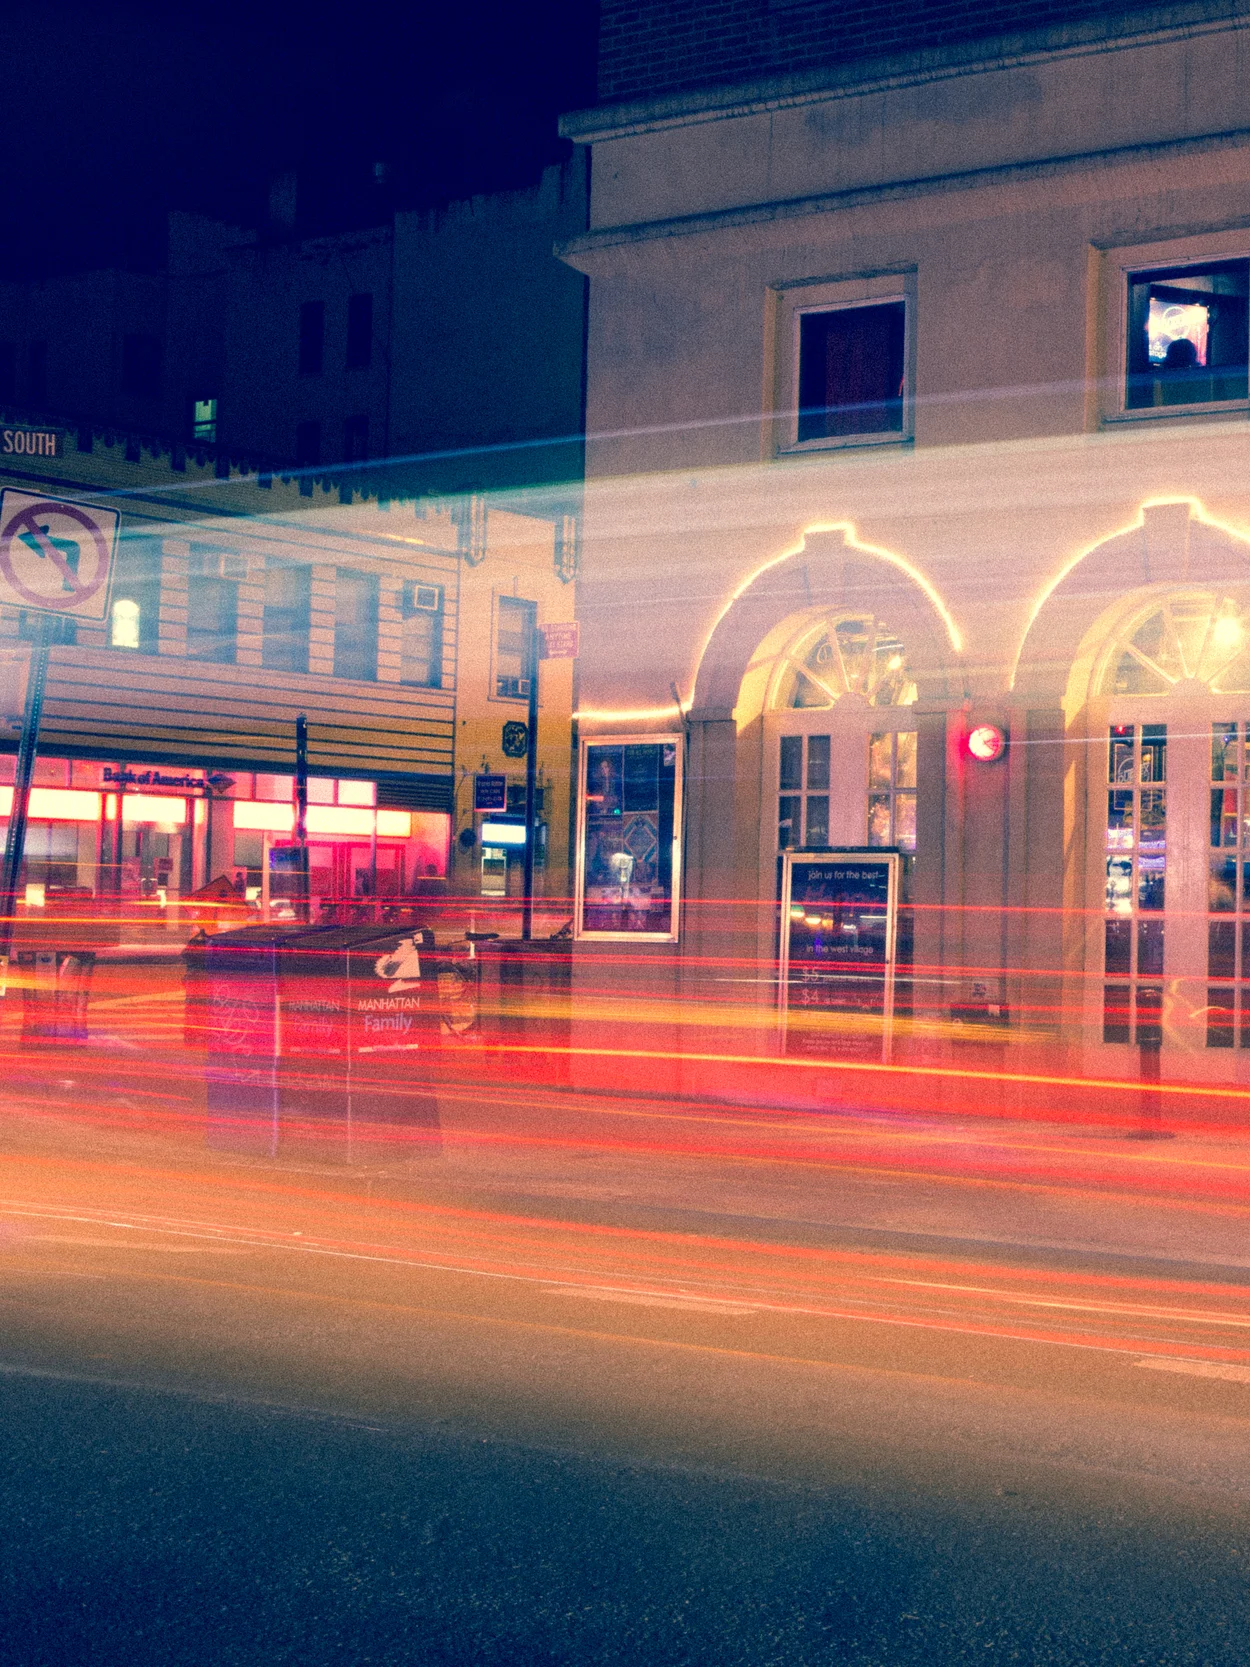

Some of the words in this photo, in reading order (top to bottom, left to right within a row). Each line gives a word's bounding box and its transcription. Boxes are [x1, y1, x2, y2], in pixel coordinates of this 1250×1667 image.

[3, 430, 56, 456] SOUTH
[103, 767, 136, 784] Bank
[137, 771, 151, 785] of
[153, 772, 205, 788] America
[808, 869, 822, 881] join
[834, 871, 845, 879] for
[846, 871, 860, 879] the
[862, 871, 879, 879] best
[358, 997, 420, 1012] MANHATTAN
[364, 1012, 414, 1035] Family
